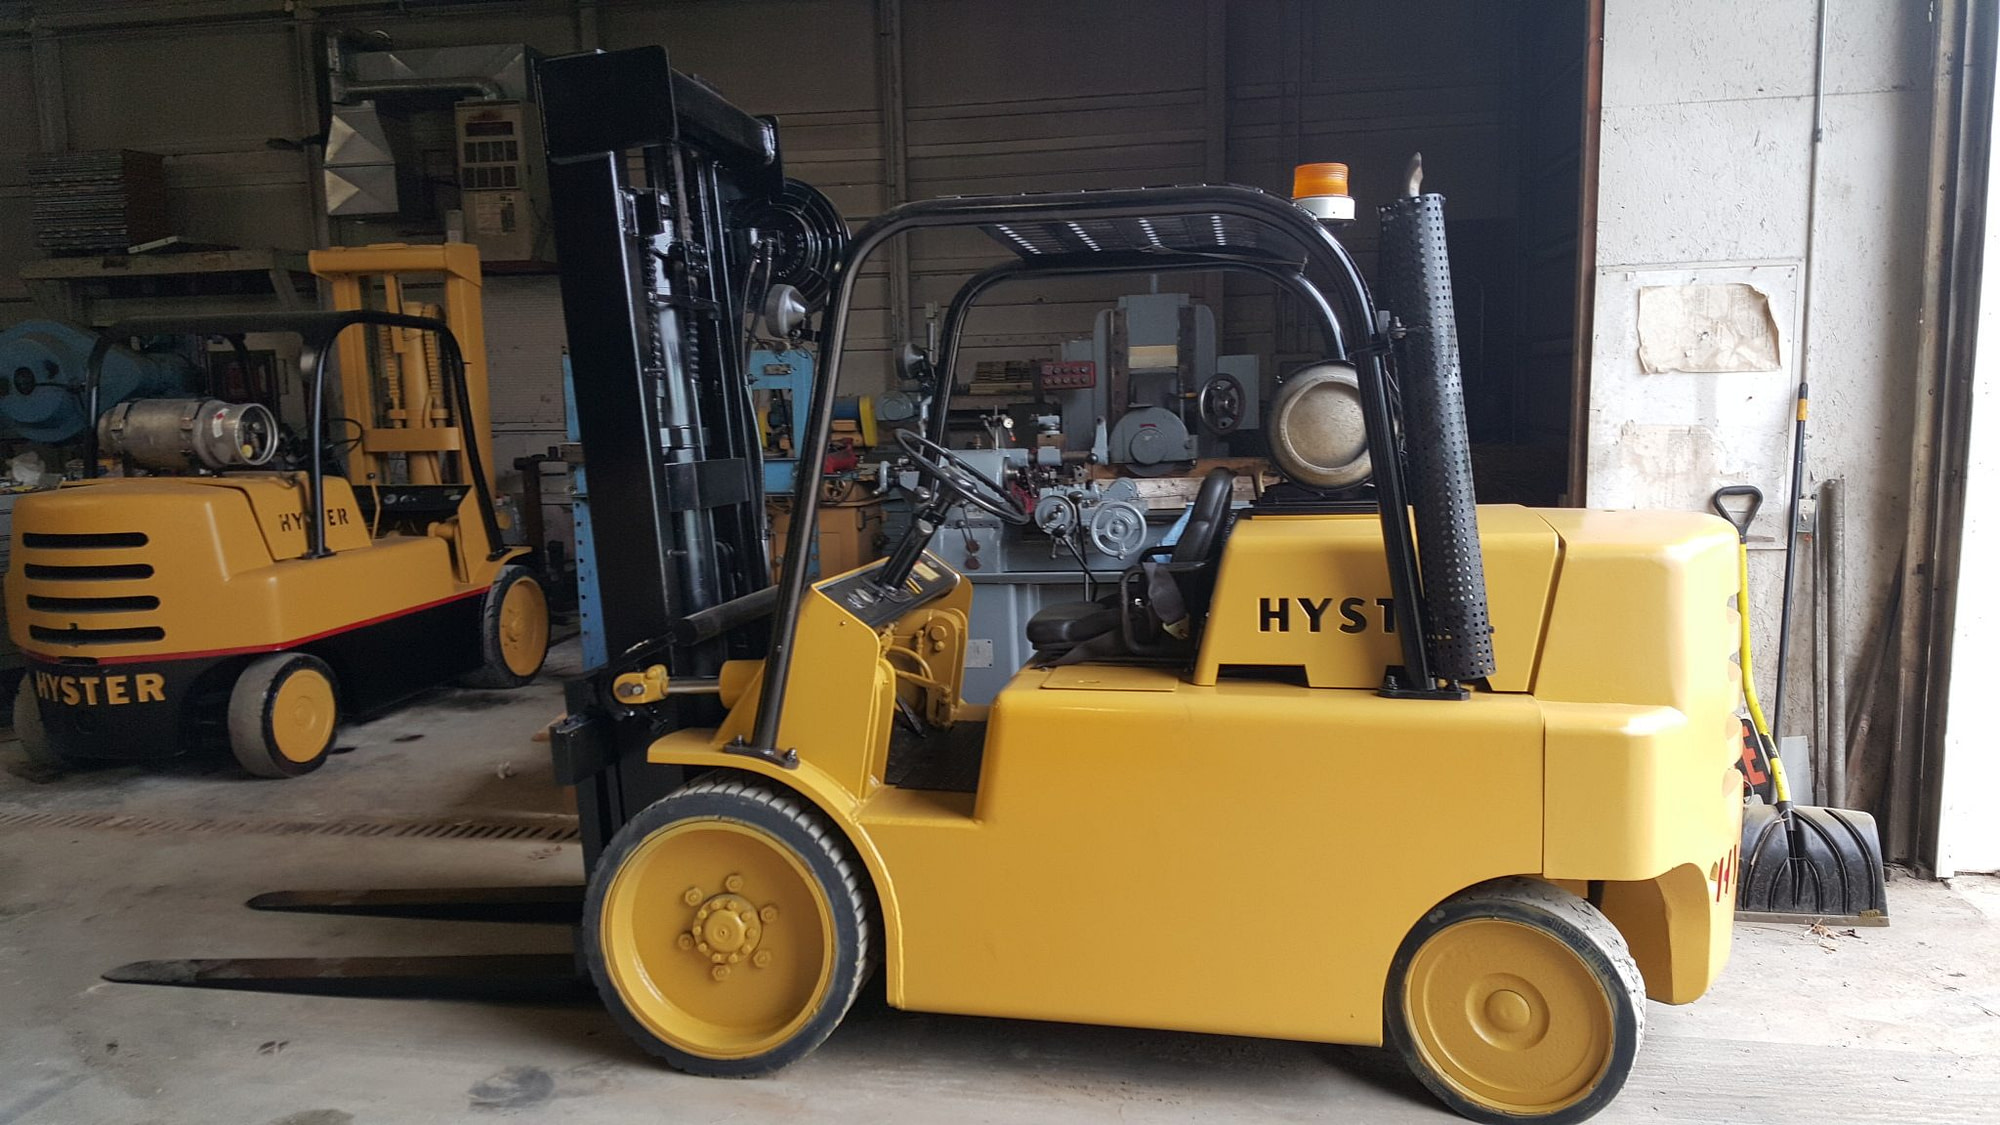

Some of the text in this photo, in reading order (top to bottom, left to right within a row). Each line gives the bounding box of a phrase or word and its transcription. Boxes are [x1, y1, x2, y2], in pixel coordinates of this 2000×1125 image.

[278, 508, 349, 532] HYER
[1258, 597, 1397, 634] HYST
[36, 670, 166, 706] HYSTER
